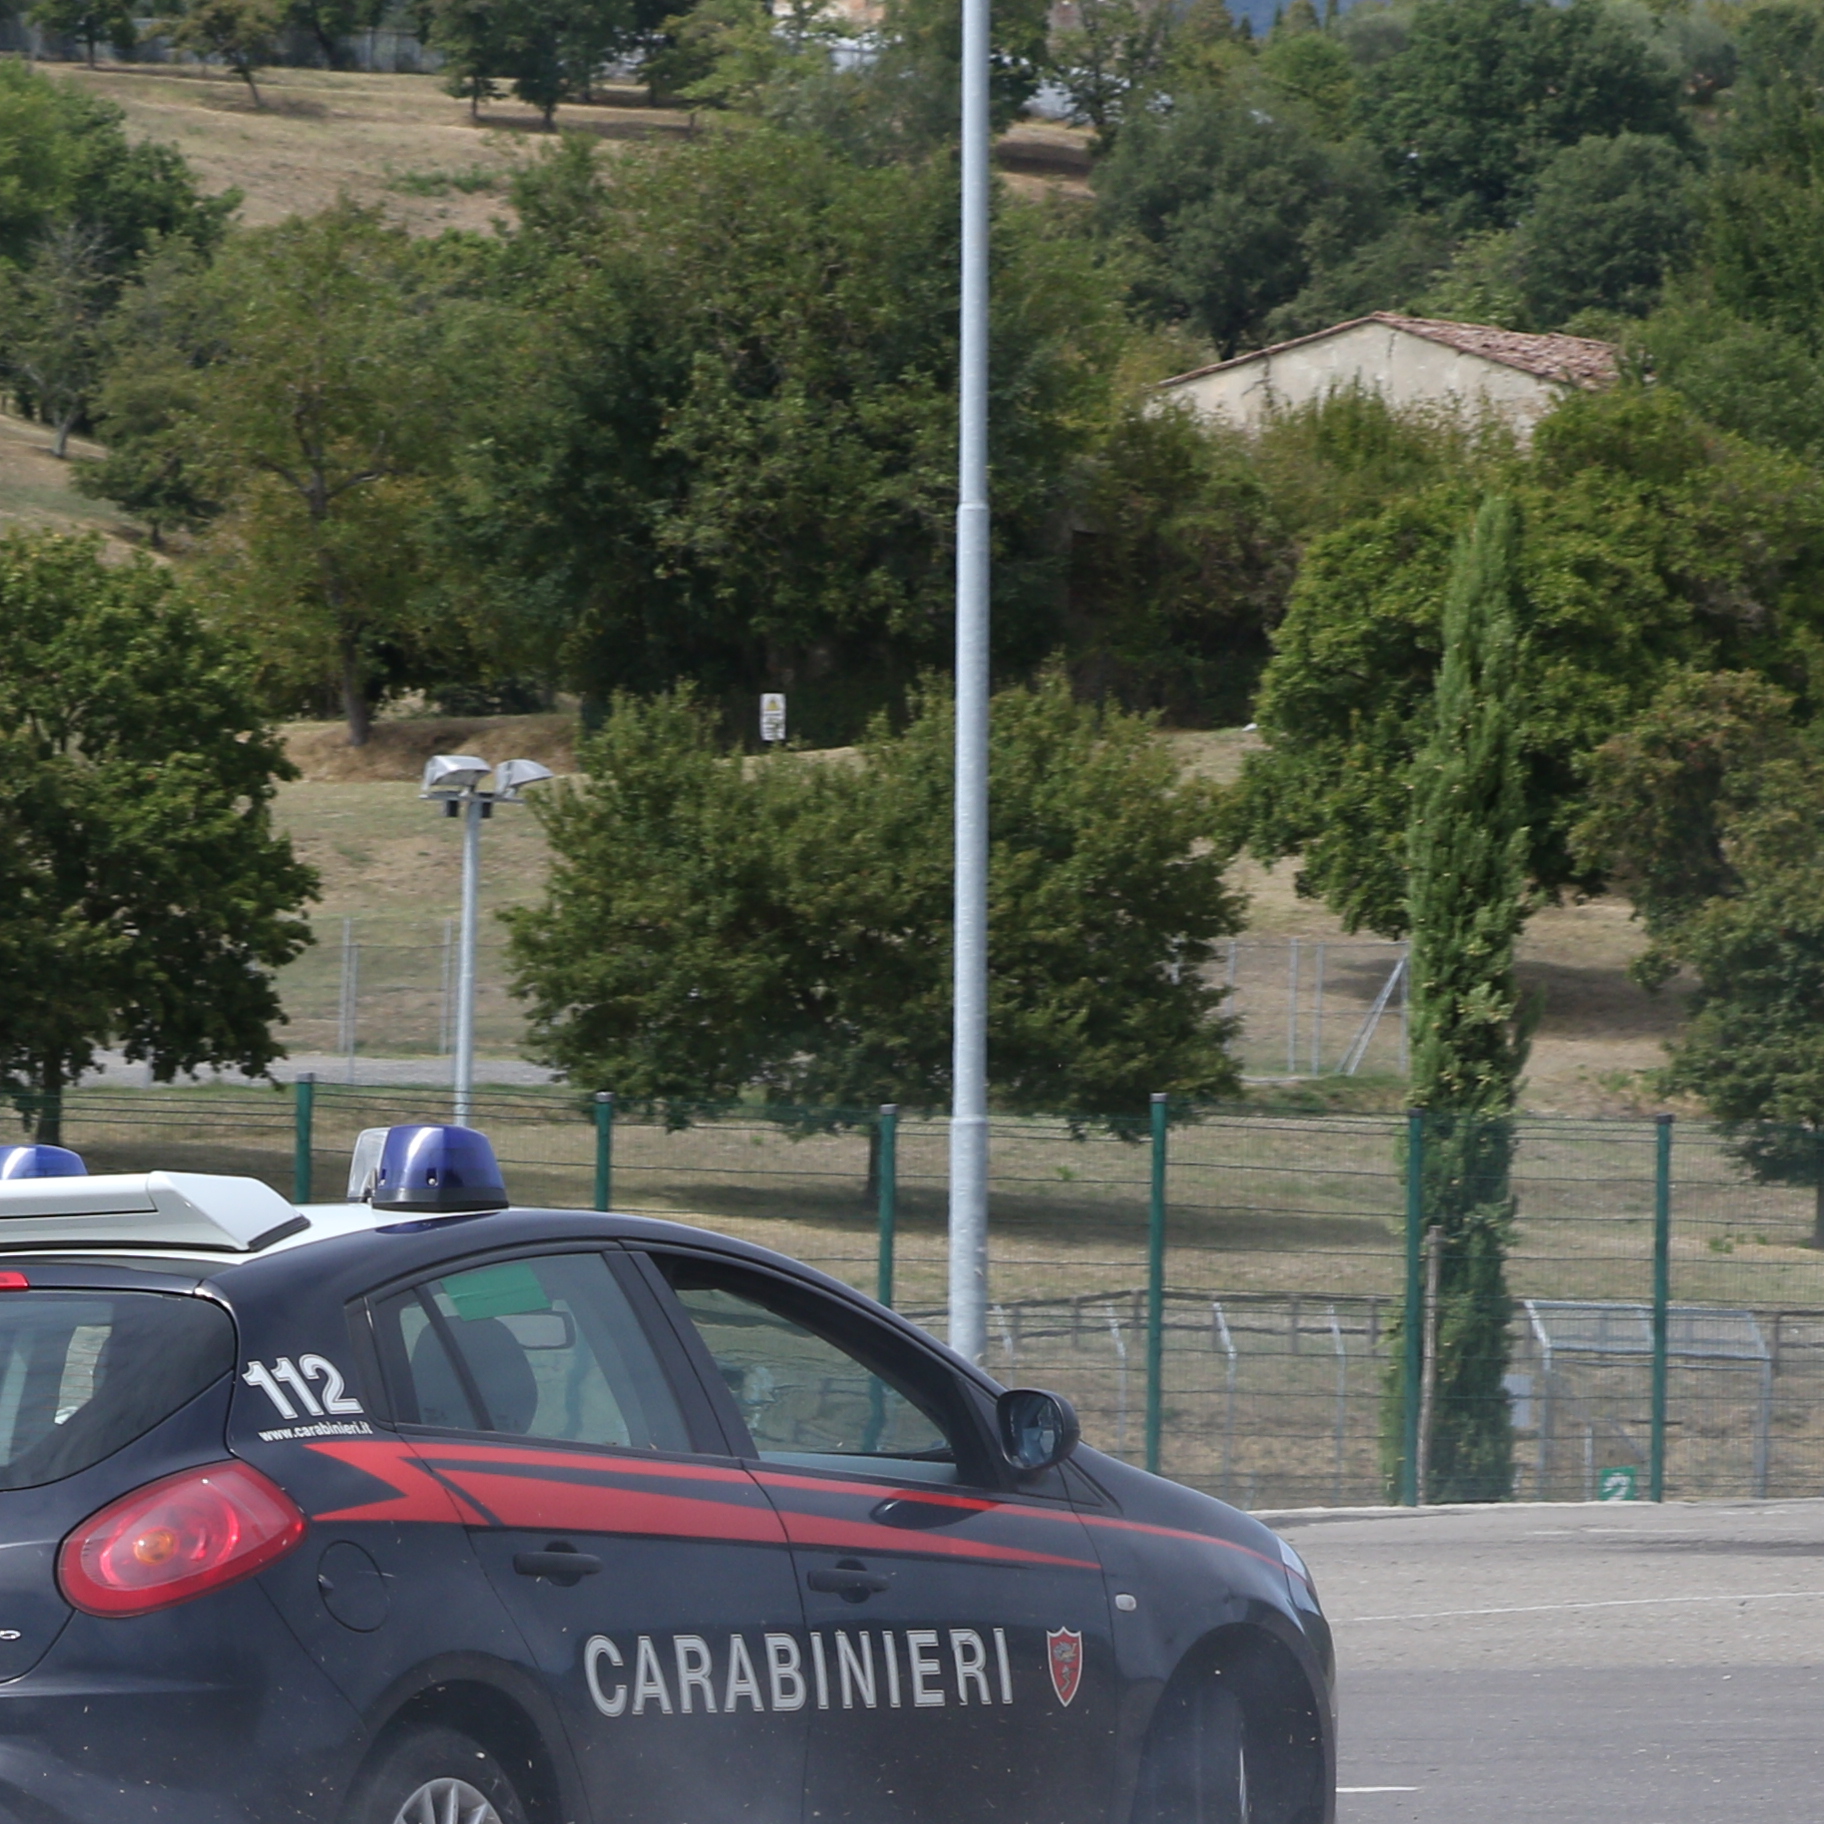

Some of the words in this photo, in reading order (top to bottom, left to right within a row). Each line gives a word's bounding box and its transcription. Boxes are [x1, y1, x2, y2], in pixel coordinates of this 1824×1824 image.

[241, 1353, 365, 1420] 112
[257, 1420, 374, 1442] www.carabinieri.it
[583, 1627, 1014, 1718] CARABINIERI
